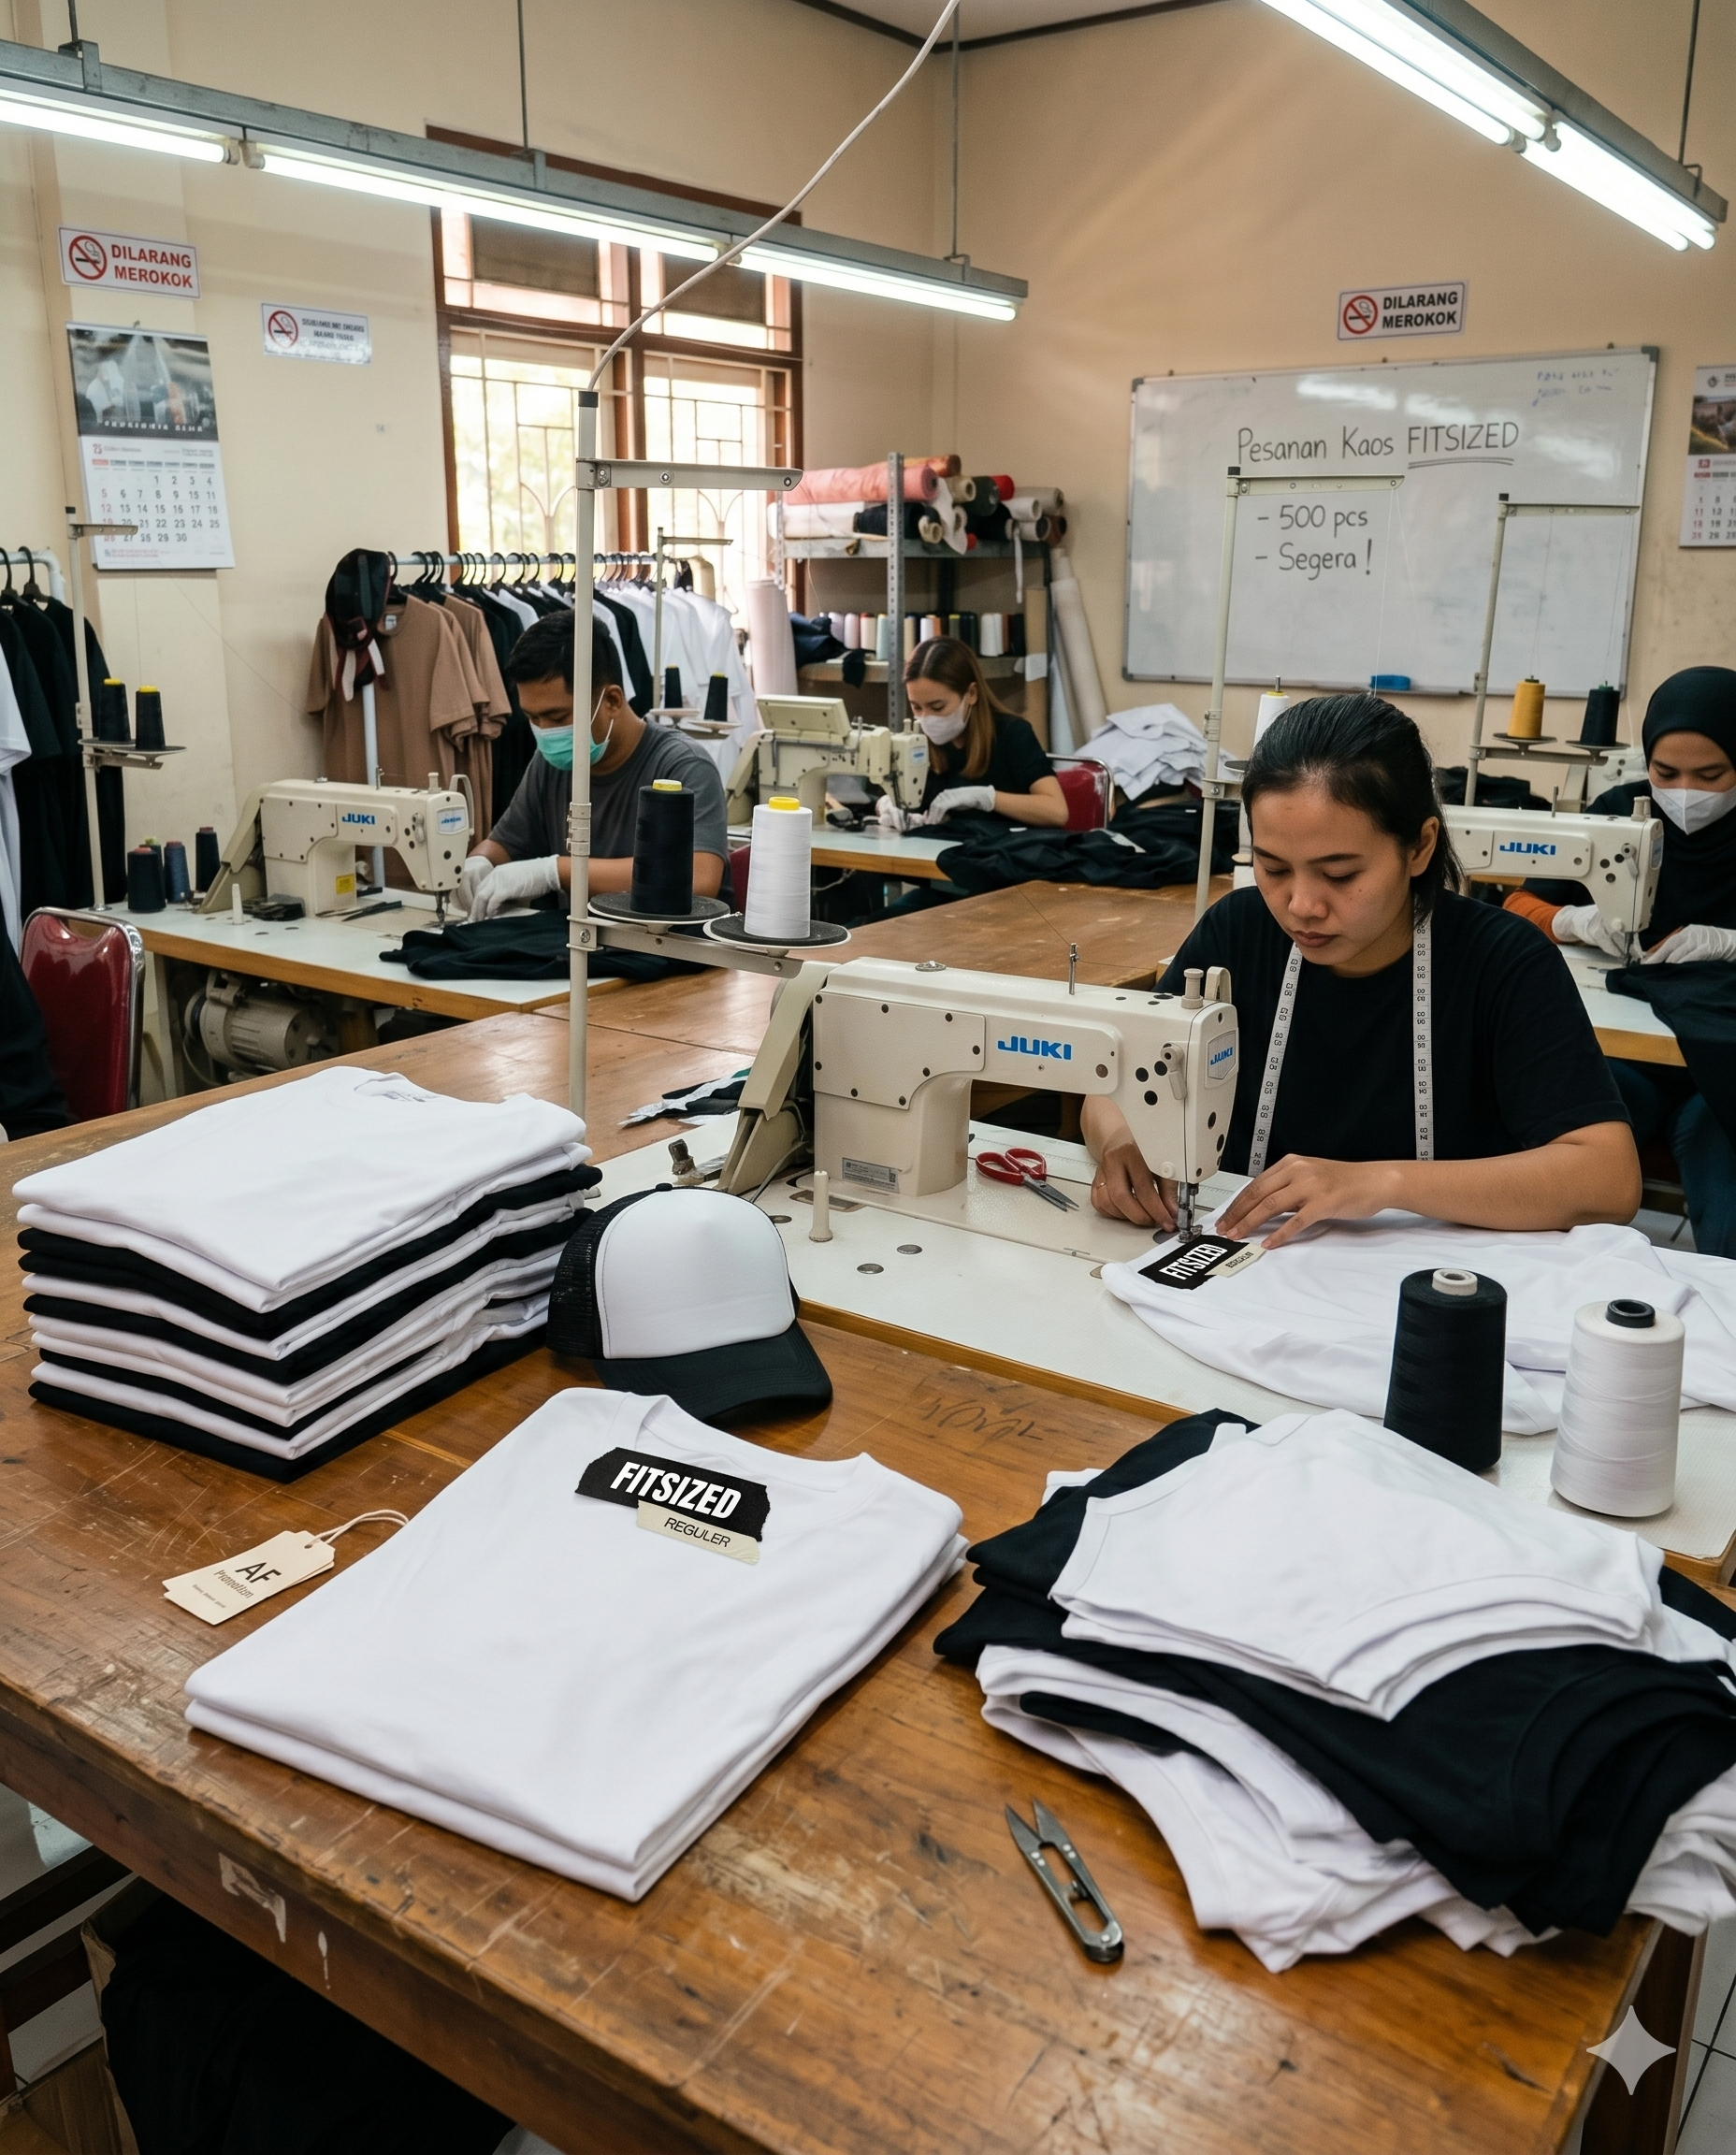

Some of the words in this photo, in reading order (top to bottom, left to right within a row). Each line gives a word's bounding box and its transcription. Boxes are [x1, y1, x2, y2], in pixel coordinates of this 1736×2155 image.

[110, 244, 192, 268] DILARANG
[114, 265, 193, 289] MEROKOK
[1382, 291, 1458, 311] DILARANG
[1382, 311, 1457, 329] MEROKOK
[1237, 427, 1326, 465] Pesanan
[1341, 425, 1394, 459] Kaos
[1407, 421, 1519, 456] FITSIZED
[1279, 504, 1326, 530] 500
[1334, 510, 1368, 539] pcs
[342, 813, 376, 825] JUKI
[1499, 842, 1556, 856] JUKI
[997, 1035, 1072, 1061] JUKI
[1158, 1243, 1228, 1280] FITSIZED
[610, 1461, 742, 1519] FITSIZED
[663, 1517, 731, 1548] REGULER
[234, 1561, 282, 1584] AF
